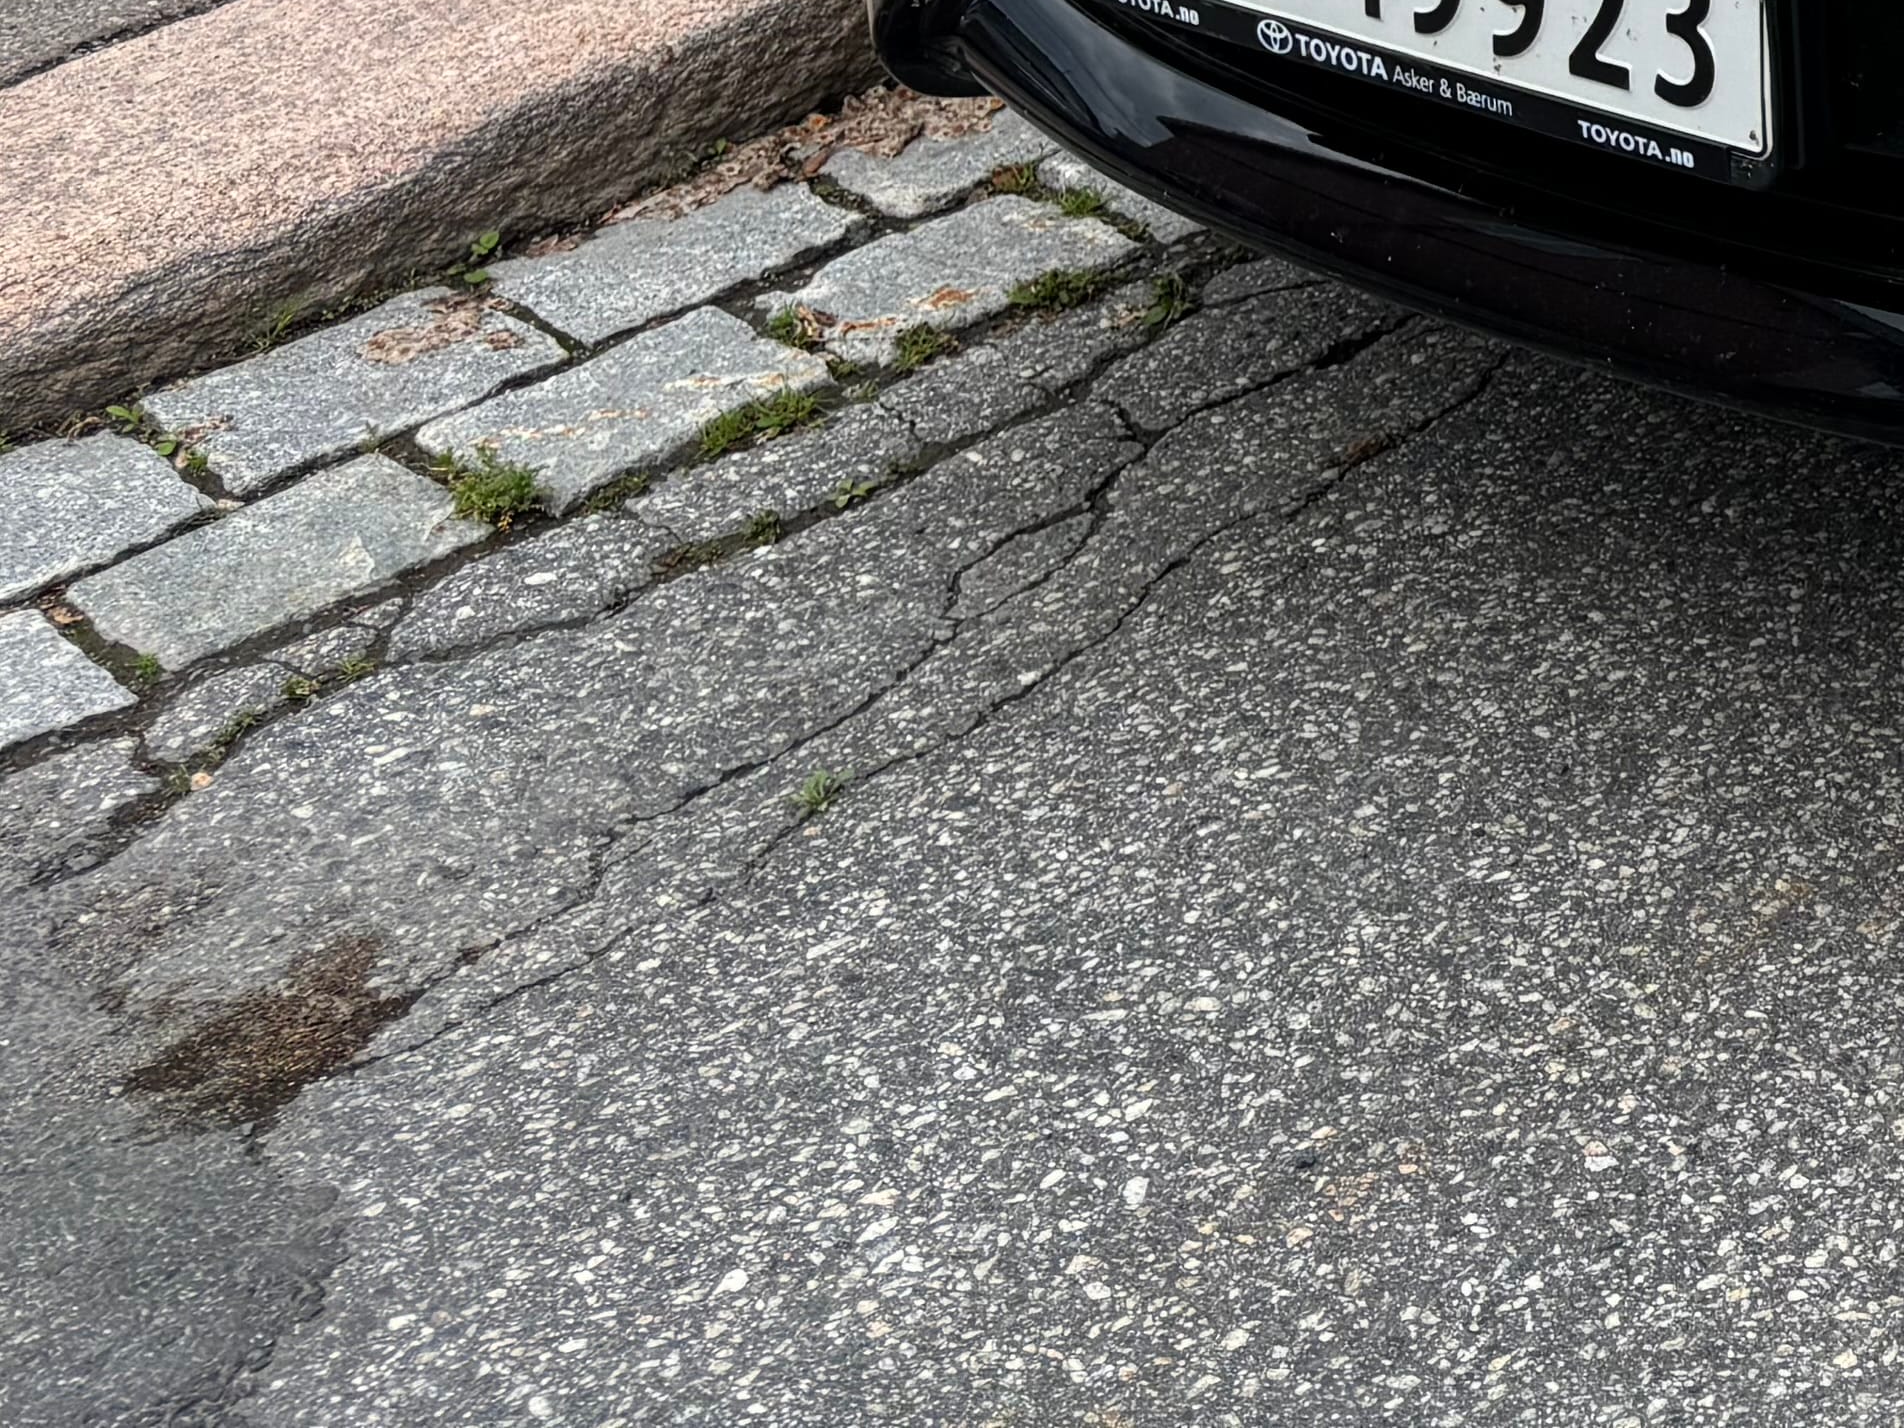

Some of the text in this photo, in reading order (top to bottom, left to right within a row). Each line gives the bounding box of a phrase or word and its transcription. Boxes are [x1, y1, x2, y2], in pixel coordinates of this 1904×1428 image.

[1295, 33, 1513, 117] TOYOTA Asker & Bærum
